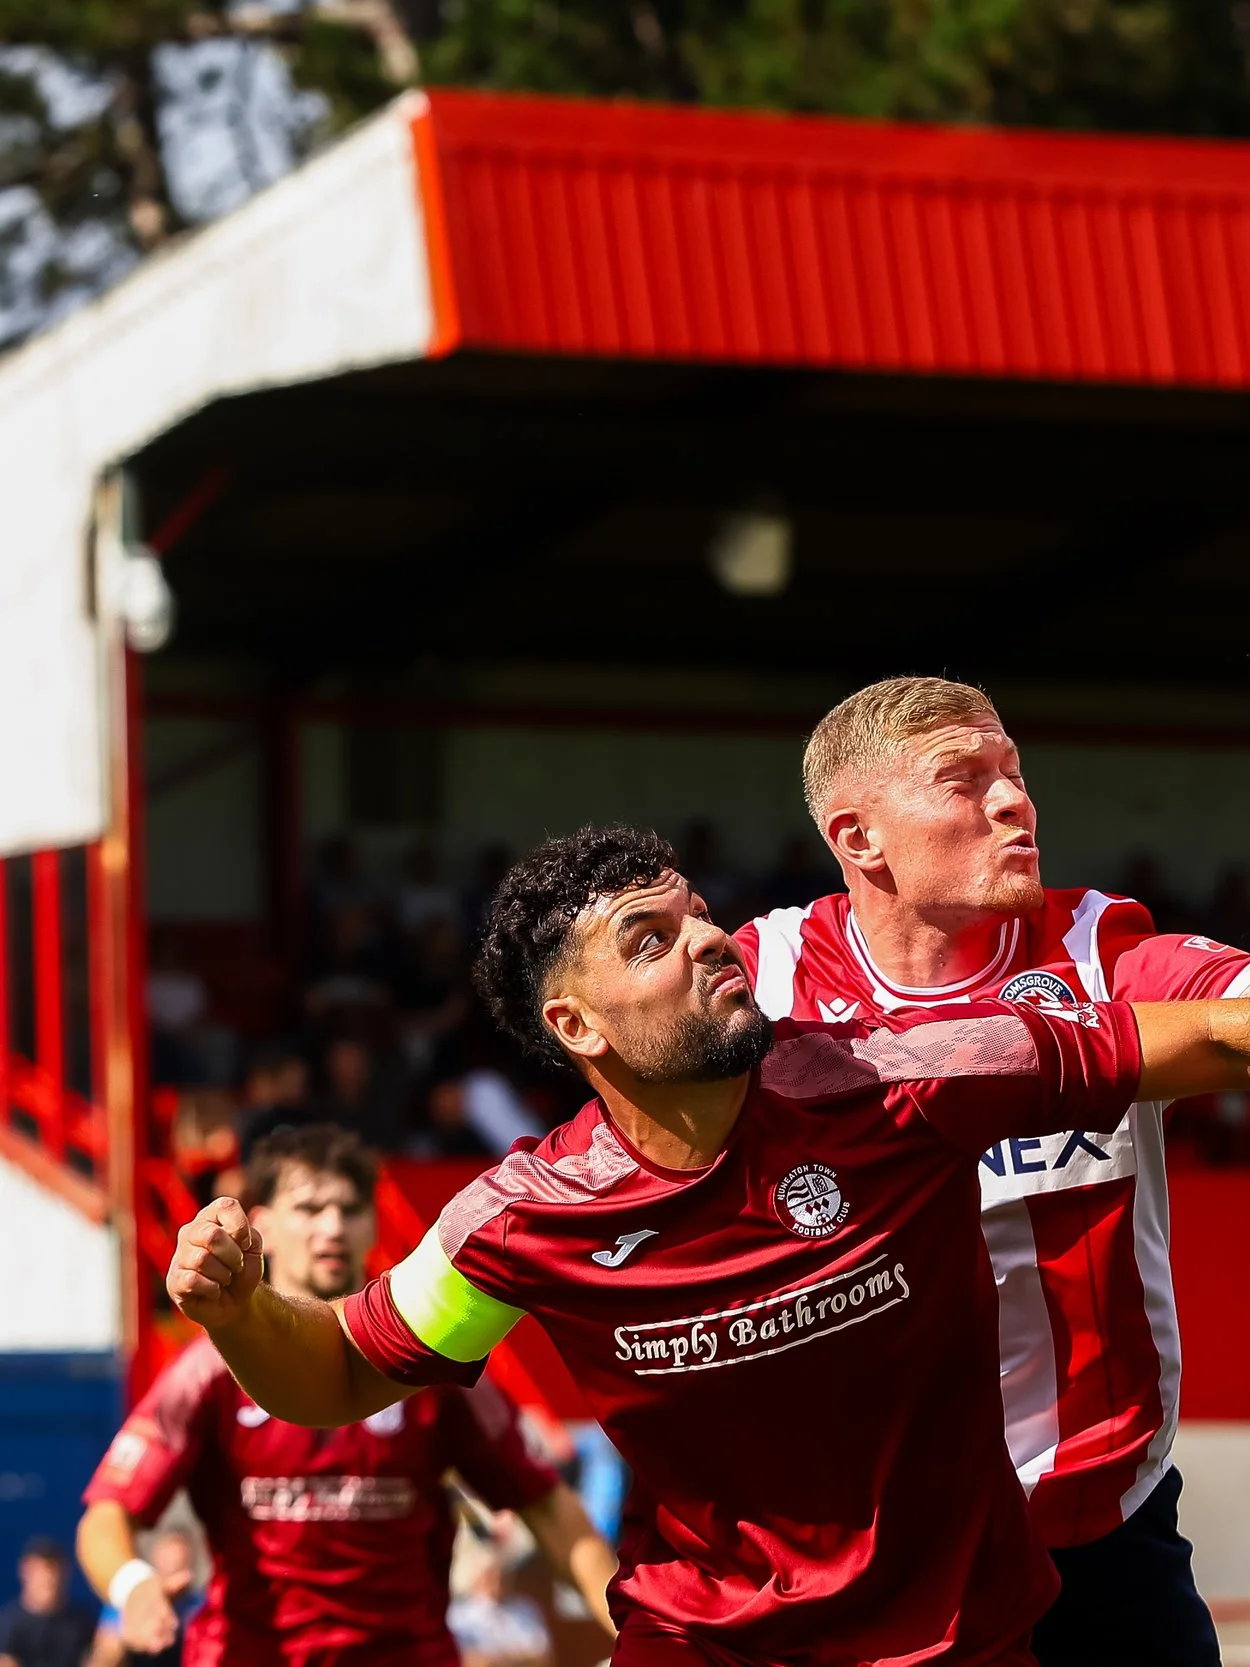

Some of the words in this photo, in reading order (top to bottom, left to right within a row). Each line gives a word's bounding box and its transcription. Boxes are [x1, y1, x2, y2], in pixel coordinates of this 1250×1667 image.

[1003, 975, 1064, 1001] OMSGROVE
[777, 1165, 809, 1200] NUNEATON
[813, 1164, 837, 1179] TOWN
[792, 1223, 836, 1236] FOOTBALL
[836, 1201, 850, 1223] CLUB
[614, 1323, 717, 1367] Simply
[729, 1263, 909, 1346] Bathrooms
